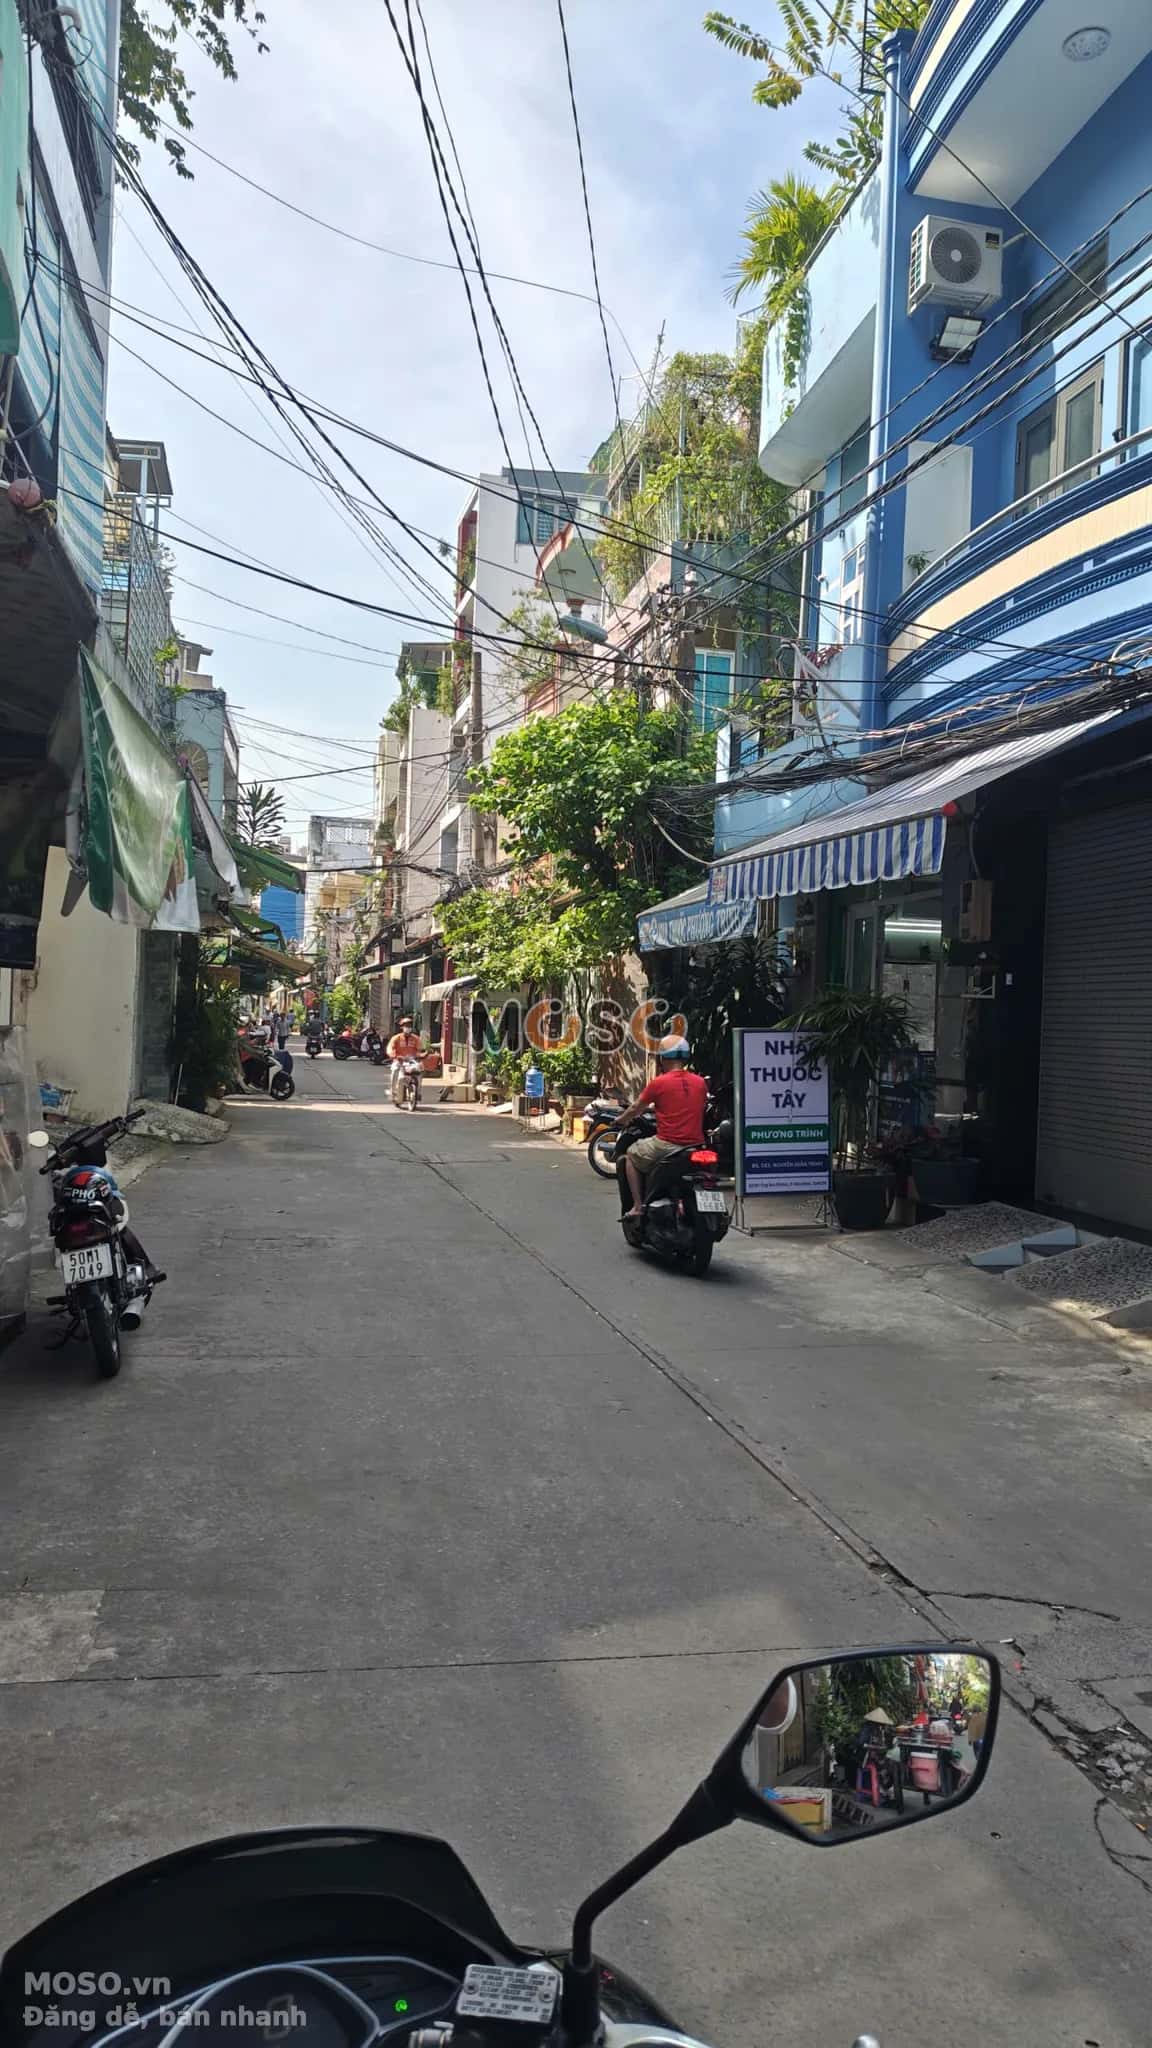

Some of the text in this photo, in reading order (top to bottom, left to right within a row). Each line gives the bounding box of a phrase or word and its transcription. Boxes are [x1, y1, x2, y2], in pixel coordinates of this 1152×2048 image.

[771, 1088, 806, 1108] TÂY
[751, 1127, 824, 1139] PHƯƠNG TRÌNH
[69, 1249, 100, 1267] 50M1
[69, 1262, 103, 1282] 7049
